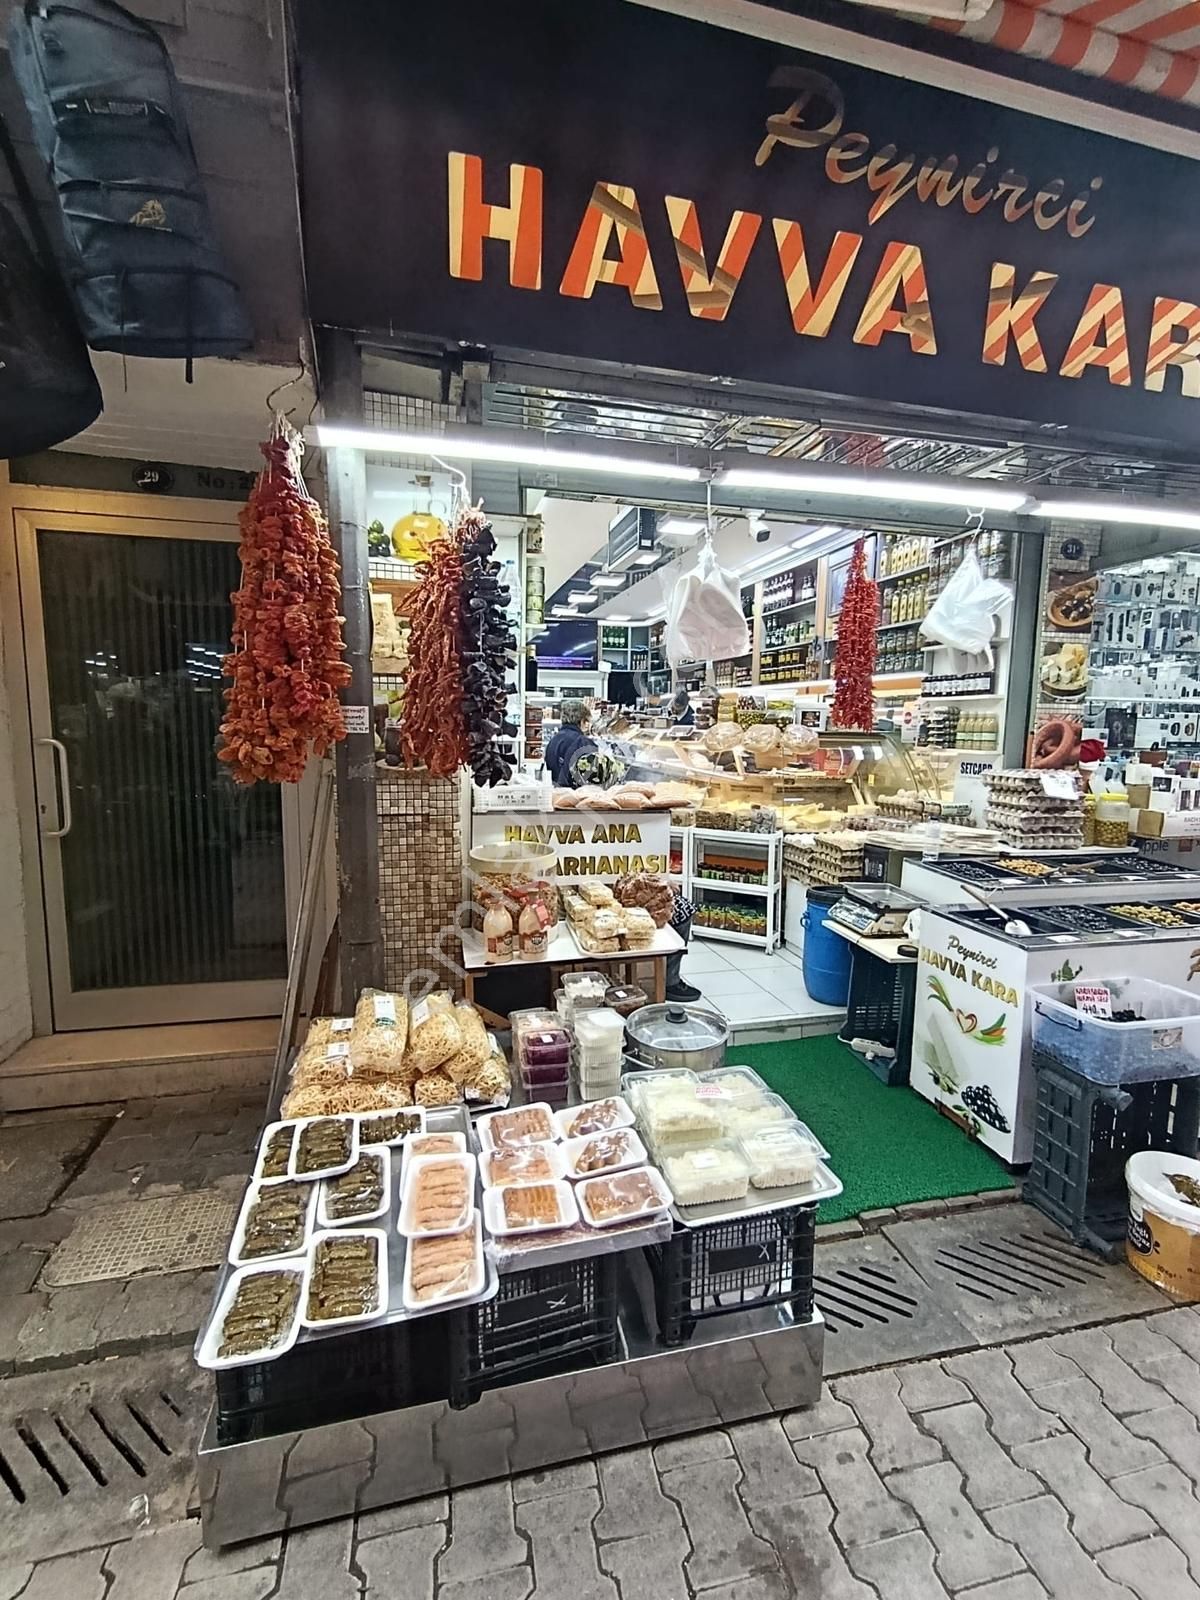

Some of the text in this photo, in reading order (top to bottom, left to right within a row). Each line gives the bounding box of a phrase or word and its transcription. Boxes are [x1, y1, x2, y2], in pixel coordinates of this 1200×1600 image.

[753, 66, 1104, 240] Peynirci
[447, 150, 938, 356] HAVVA
[144, 470, 159, 483] 29
[504, 824, 642, 844] HAVVA ANA
[1141, 840, 1170, 855] pple
[551, 855, 667, 877] ARHANASI
[947, 934, 998, 969] Peynirci
[920, 946, 1019, 1008] HAVVA KARA
